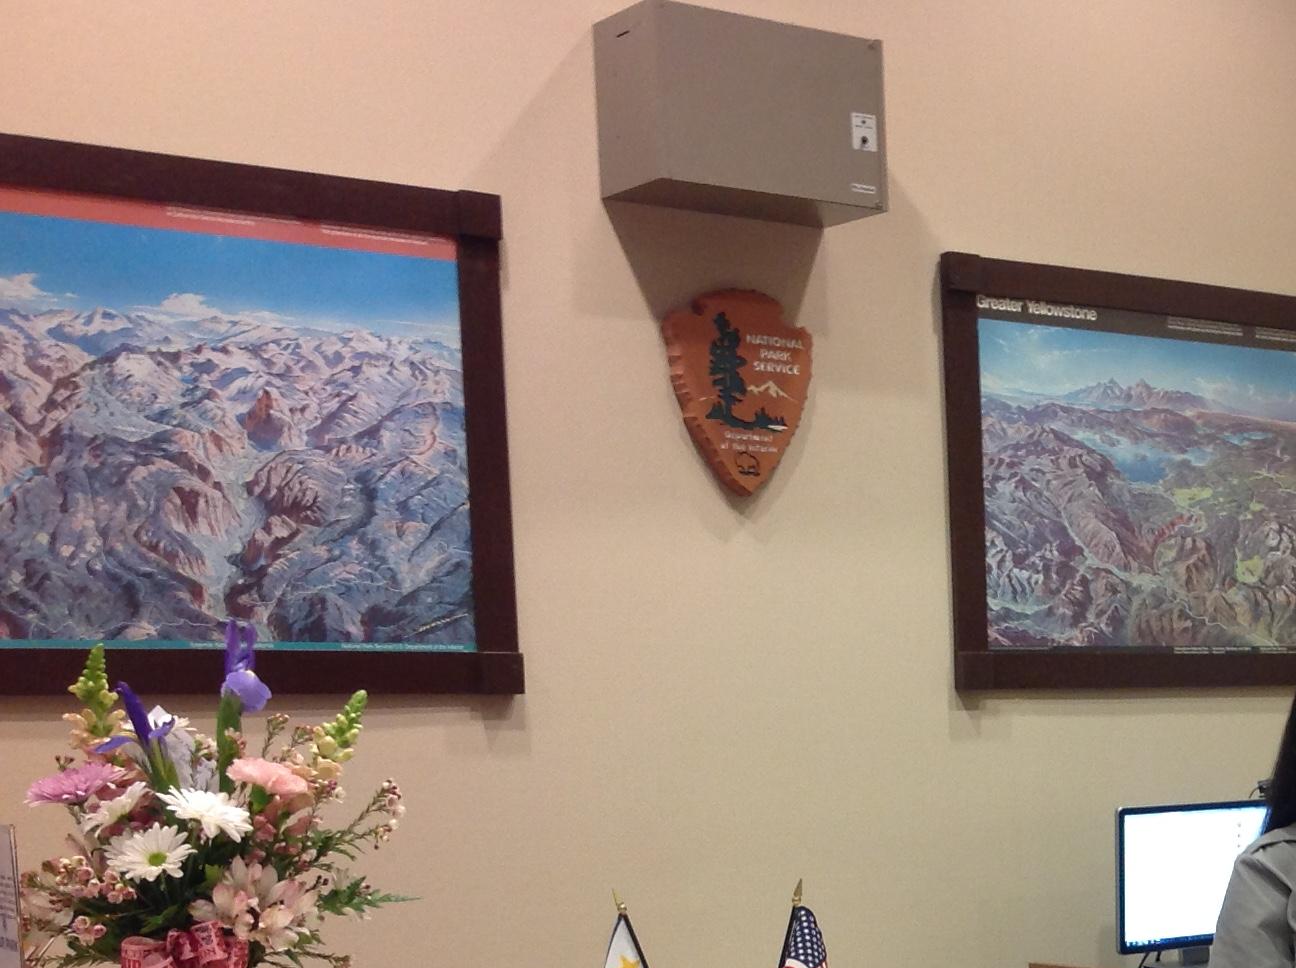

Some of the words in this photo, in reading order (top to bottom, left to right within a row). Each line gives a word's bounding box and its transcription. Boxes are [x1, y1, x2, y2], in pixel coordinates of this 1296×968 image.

[976, 294, 1023, 313] Greater
[1025, 300, 1098, 321] Yellowstone
[745, 334, 804, 349] NATIONAL
[759, 350, 792, 361] PARK
[753, 361, 801, 376] SERVICE
